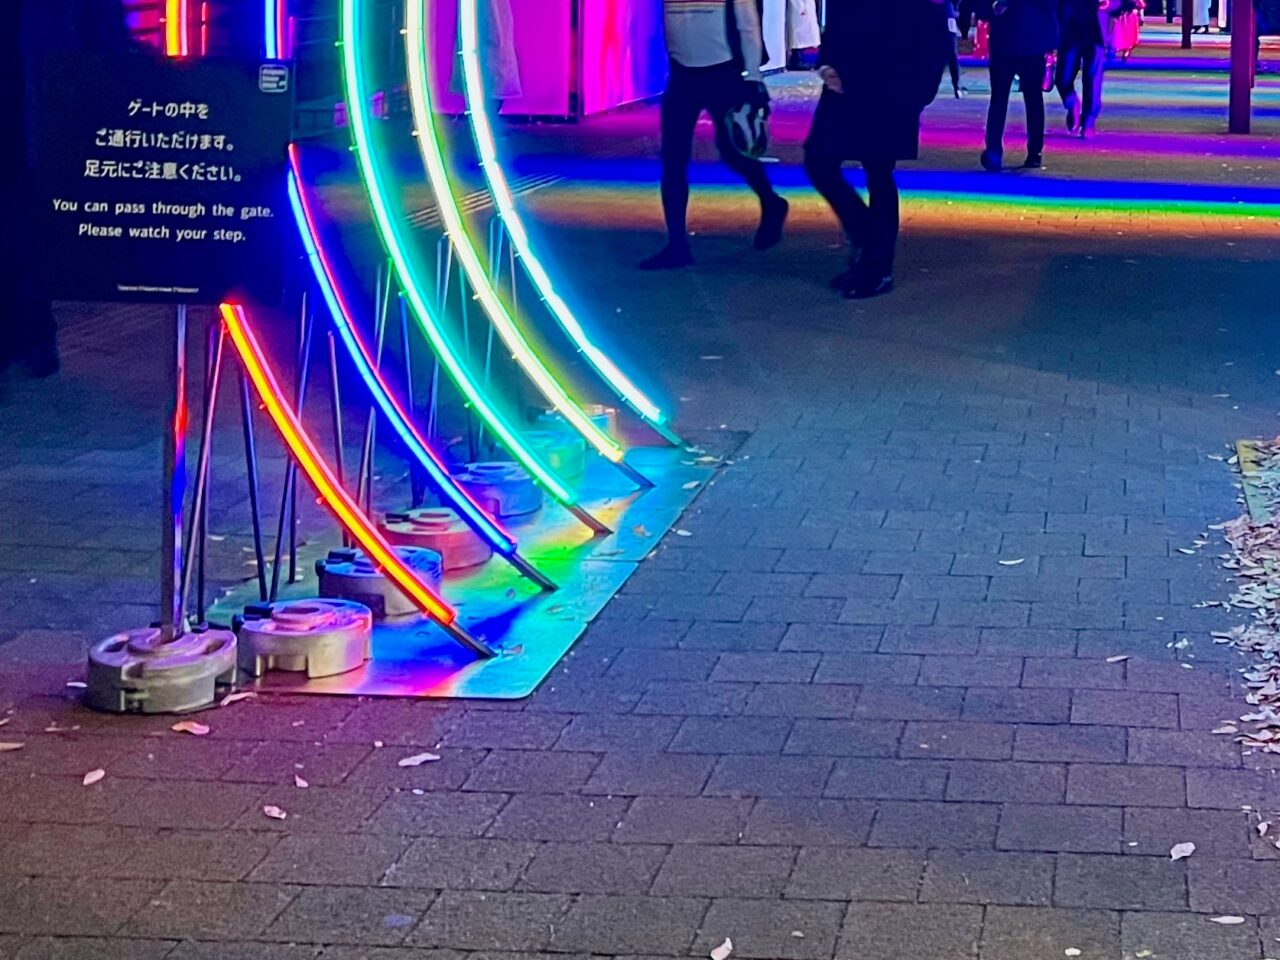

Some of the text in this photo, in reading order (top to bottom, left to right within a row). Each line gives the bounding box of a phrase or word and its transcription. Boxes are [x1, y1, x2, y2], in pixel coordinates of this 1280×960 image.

[128, 98, 209, 120] ゲートの中を
[95, 128, 234, 151] ご通行いただけます。
[84, 159, 241, 182] 足元にご注意ください。
[52, 198, 274, 220] You can pass through the gate.
[78, 223, 246, 243] Please watch your step.
